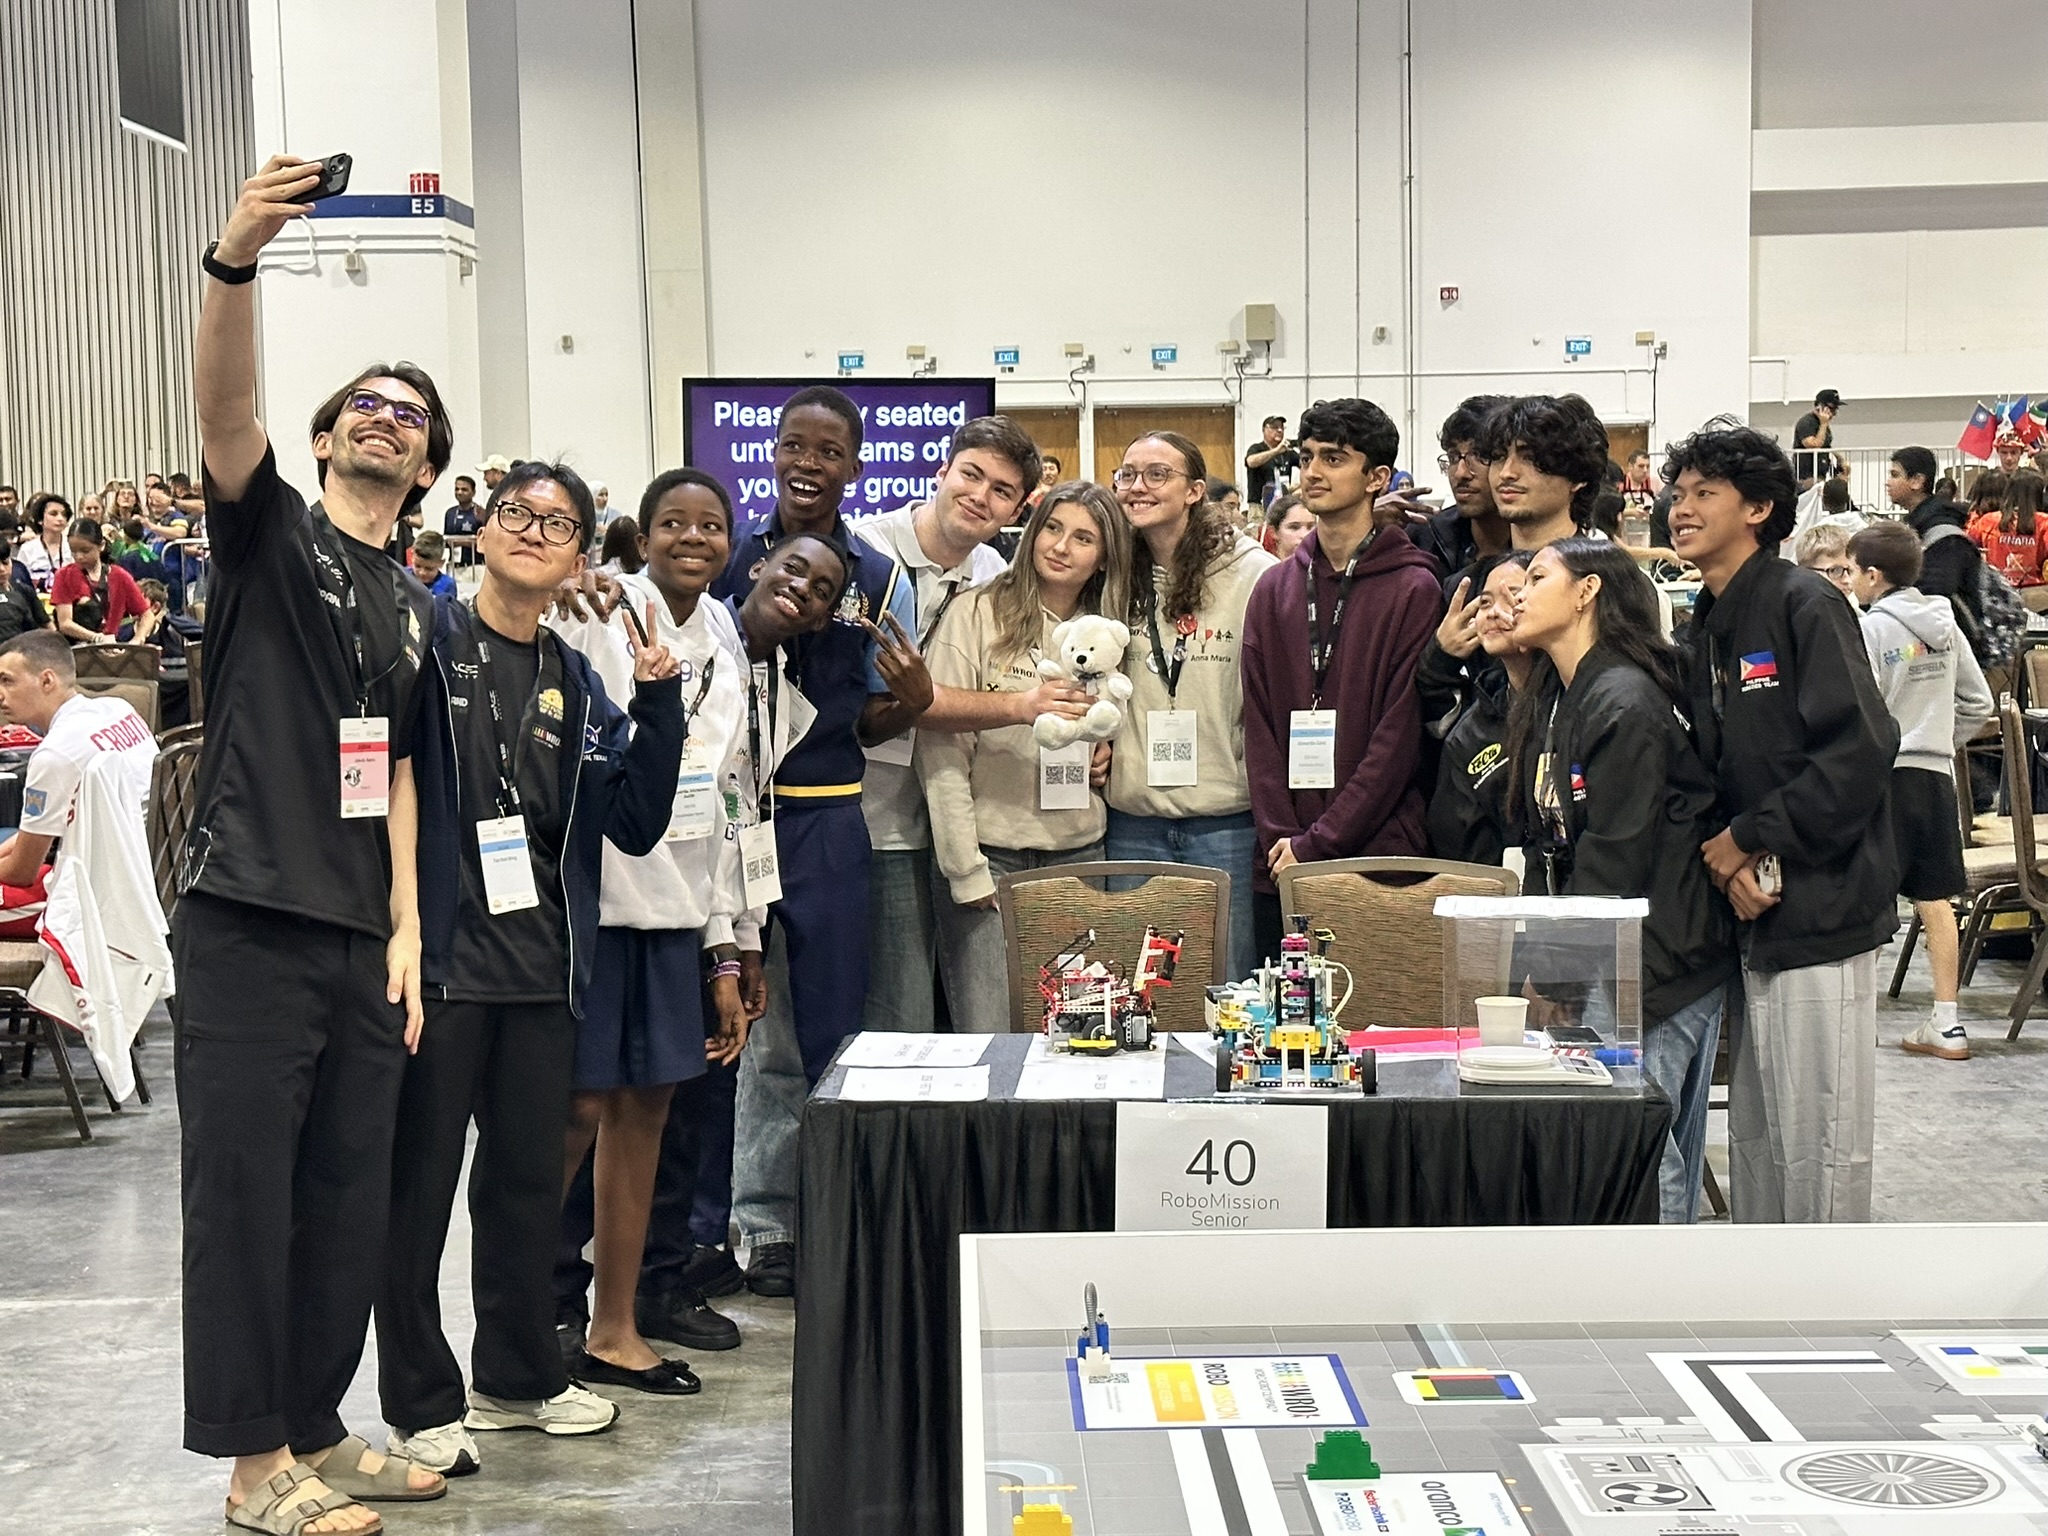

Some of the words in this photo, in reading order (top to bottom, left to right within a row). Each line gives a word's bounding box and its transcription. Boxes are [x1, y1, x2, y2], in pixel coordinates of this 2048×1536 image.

[411, 198, 435, 214] E5
[843, 357, 859, 367] EXIT
[998, 352, 1015, 362] EXIT
[1155, 350, 1171, 360] EXIT
[714, 401, 783, 427] Pleas
[876, 400, 965, 426] seated
[922, 435, 951, 461] of
[1190, 654, 1209, 662] Anna
[1211, 654, 1232, 663] Maria
[1908, 661, 1946, 676] SERBIA
[90, 712, 151, 752] CROATI
[1185, 1138, 1256, 1186] 40
[1161, 1191, 1280, 1210] RoboMission
[1191, 1210, 1249, 1228] Senior
[1280, 1388, 1319, 1413] WRO
[1421, 1481, 1463, 1525] aramco
